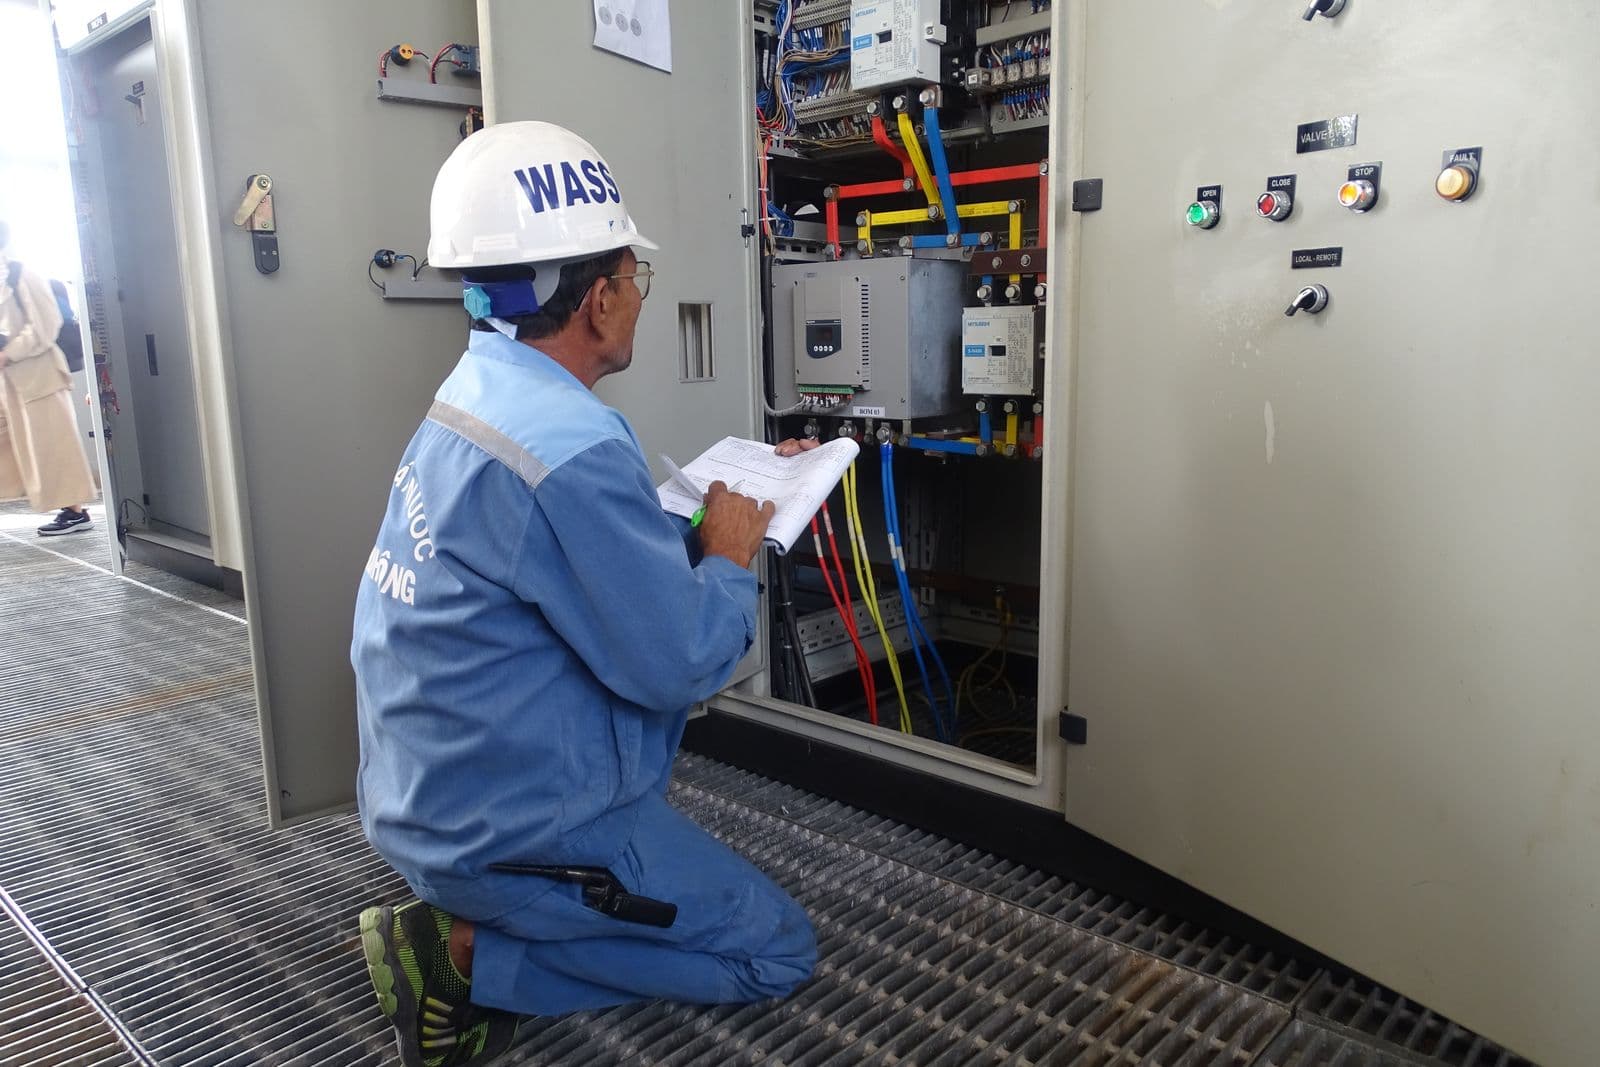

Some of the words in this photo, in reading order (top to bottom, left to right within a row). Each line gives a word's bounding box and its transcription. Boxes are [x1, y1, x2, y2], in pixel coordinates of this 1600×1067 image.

[1301, 130, 1327, 144] VALVE
[1449, 152, 1476, 162] FAULT
[1355, 167, 1374, 177] STOP
[514, 159, 621, 213] WASS
[1271, 178, 1291, 187] CLOSE
[1202, 189, 1217, 198] OPEN
[1295, 255, 1312, 263] LOCAL
[1316, 253, 1338, 262] REMOTE
